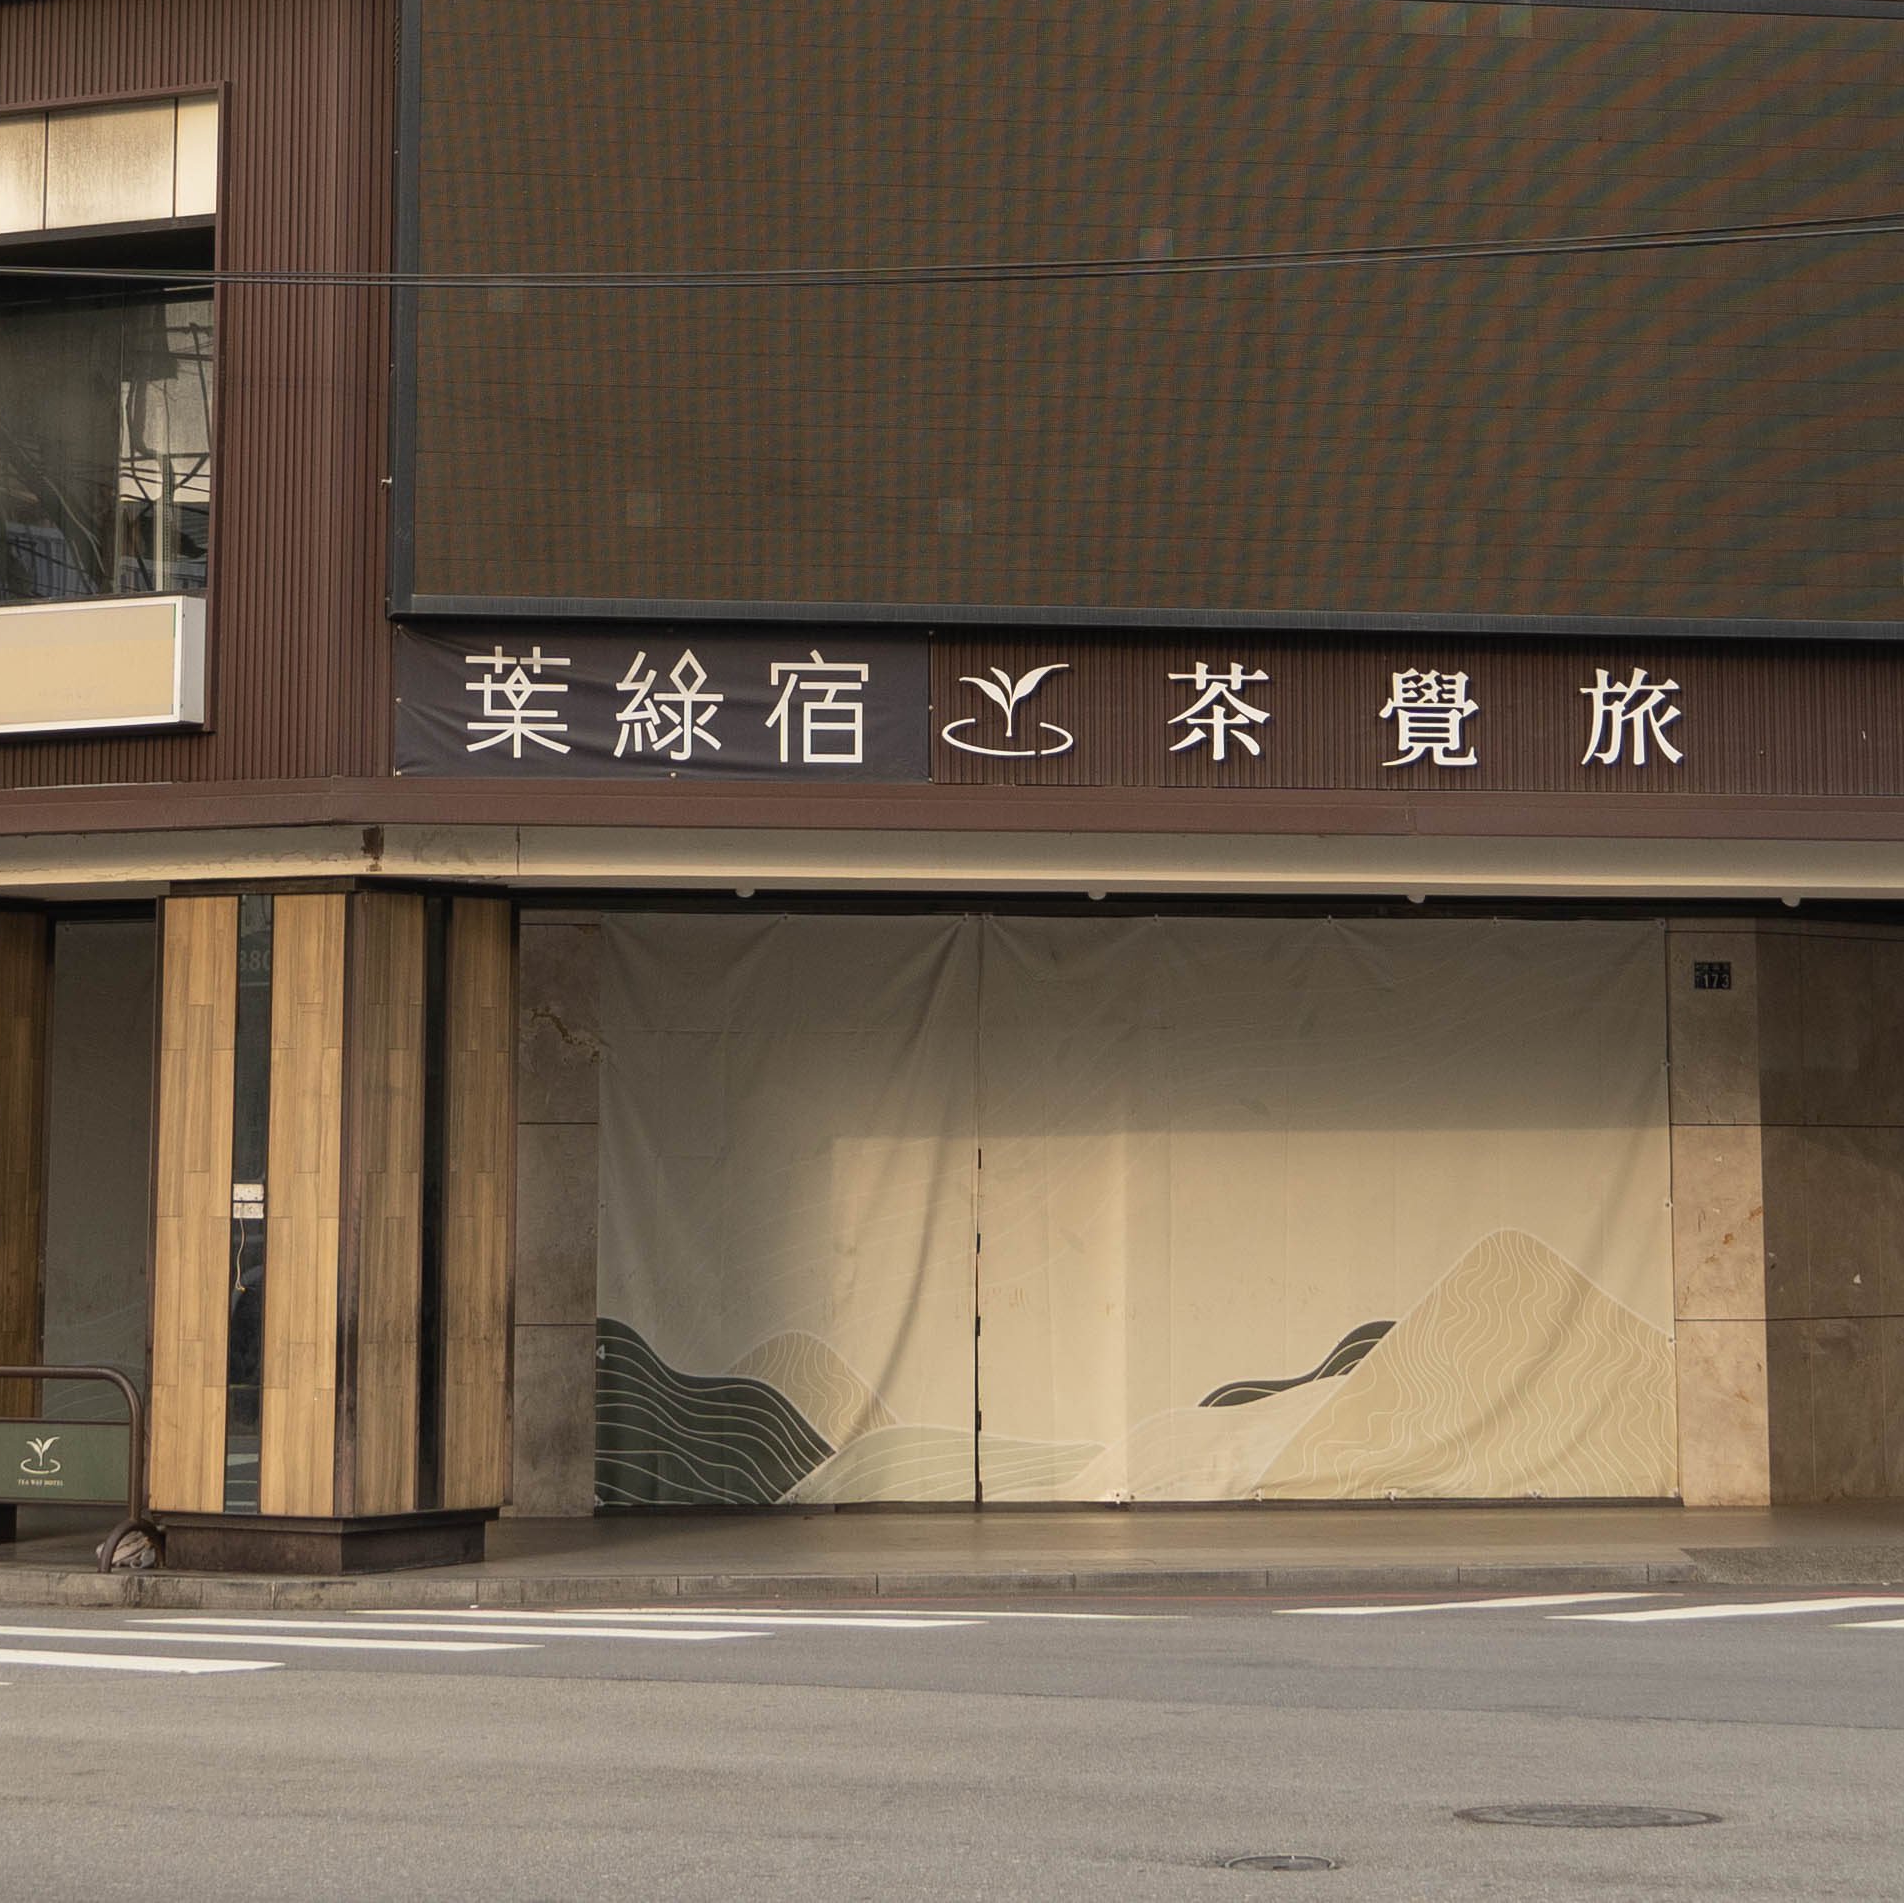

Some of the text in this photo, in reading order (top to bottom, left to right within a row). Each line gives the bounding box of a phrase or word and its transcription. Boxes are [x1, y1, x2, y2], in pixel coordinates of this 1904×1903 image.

[464, 646, 1685, 768] 葉綠宿 茶覺旅
[1703, 973, 1731, 989] 173
